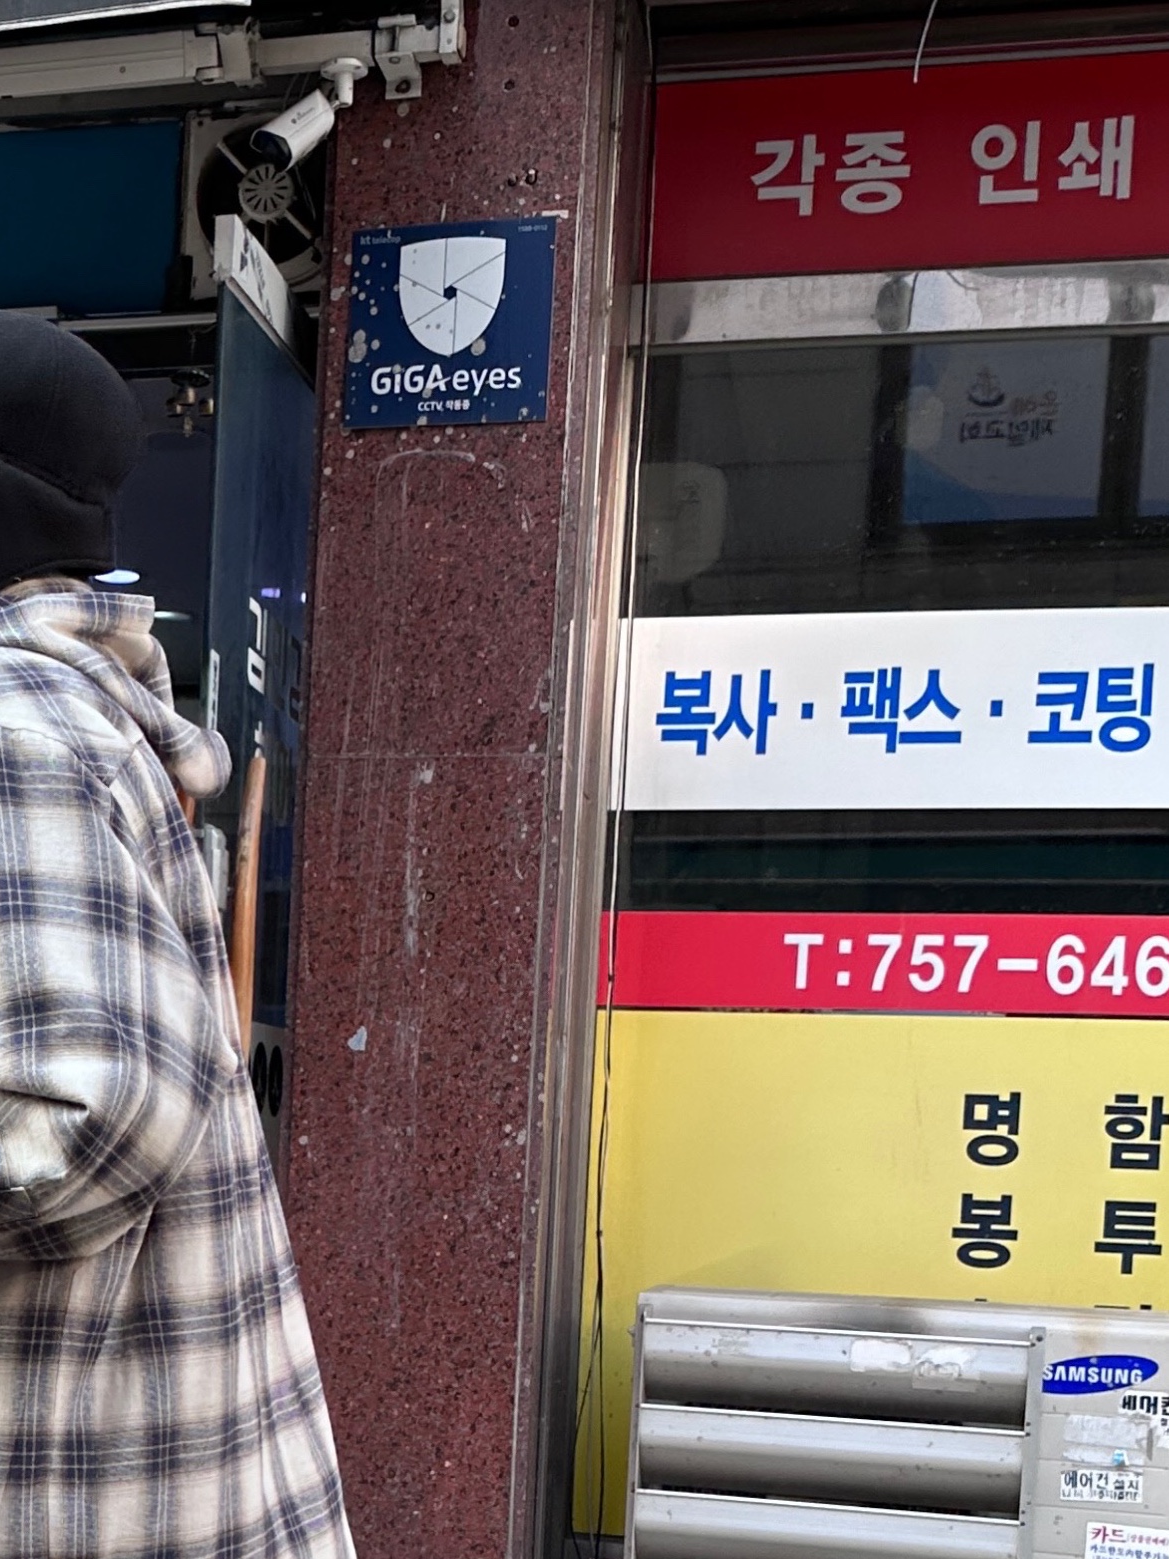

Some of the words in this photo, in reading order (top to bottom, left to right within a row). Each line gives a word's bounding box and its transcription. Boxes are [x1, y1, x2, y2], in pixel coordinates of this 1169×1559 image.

[750, 130, 911, 217] 각종
[970, 114, 1136, 206] 인쇄
[655, 668, 778, 756] 복사
[840, 666, 962, 754] 팩스
[1027, 663, 1155, 753] 코팅
[1042, 1364, 1144, 1385] SAMSUNG
[1089, 1525, 1127, 1544] 카드
